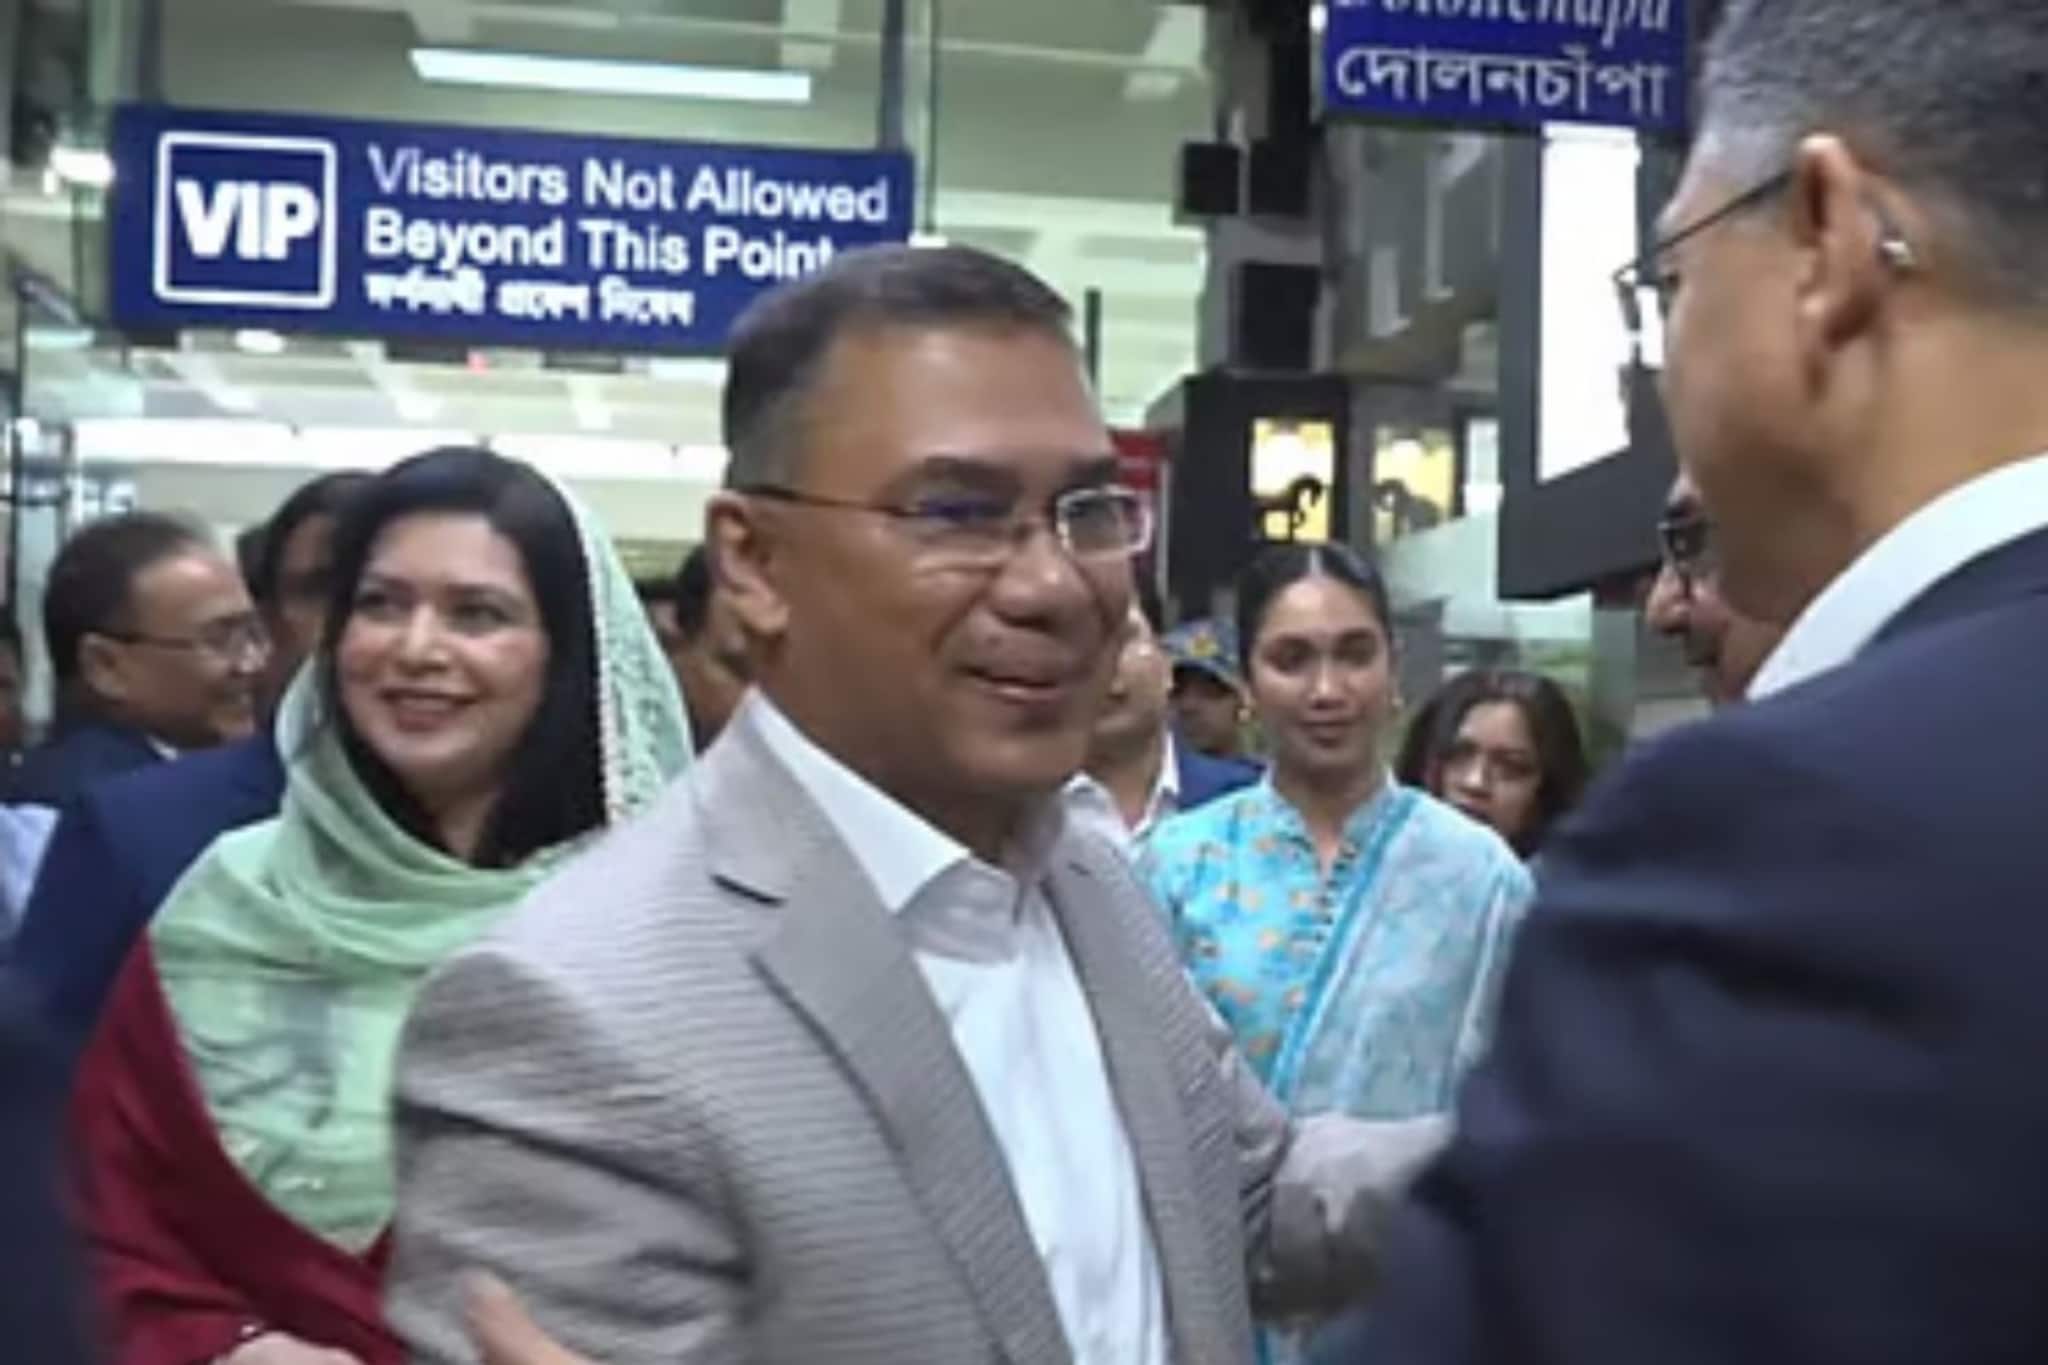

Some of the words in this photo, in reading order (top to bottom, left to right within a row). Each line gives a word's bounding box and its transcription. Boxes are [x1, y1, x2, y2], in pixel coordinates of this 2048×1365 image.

[1336, 42, 1670, 117] দোলনচাঁপা
[174, 180, 320, 261] VIP
[367, 143, 569, 205] Visitors
[582, 157, 675, 211] Not
[686, 165, 888, 222] Allowed
[366, 206, 565, 270] Beyond
[577, 216, 690, 274] This
